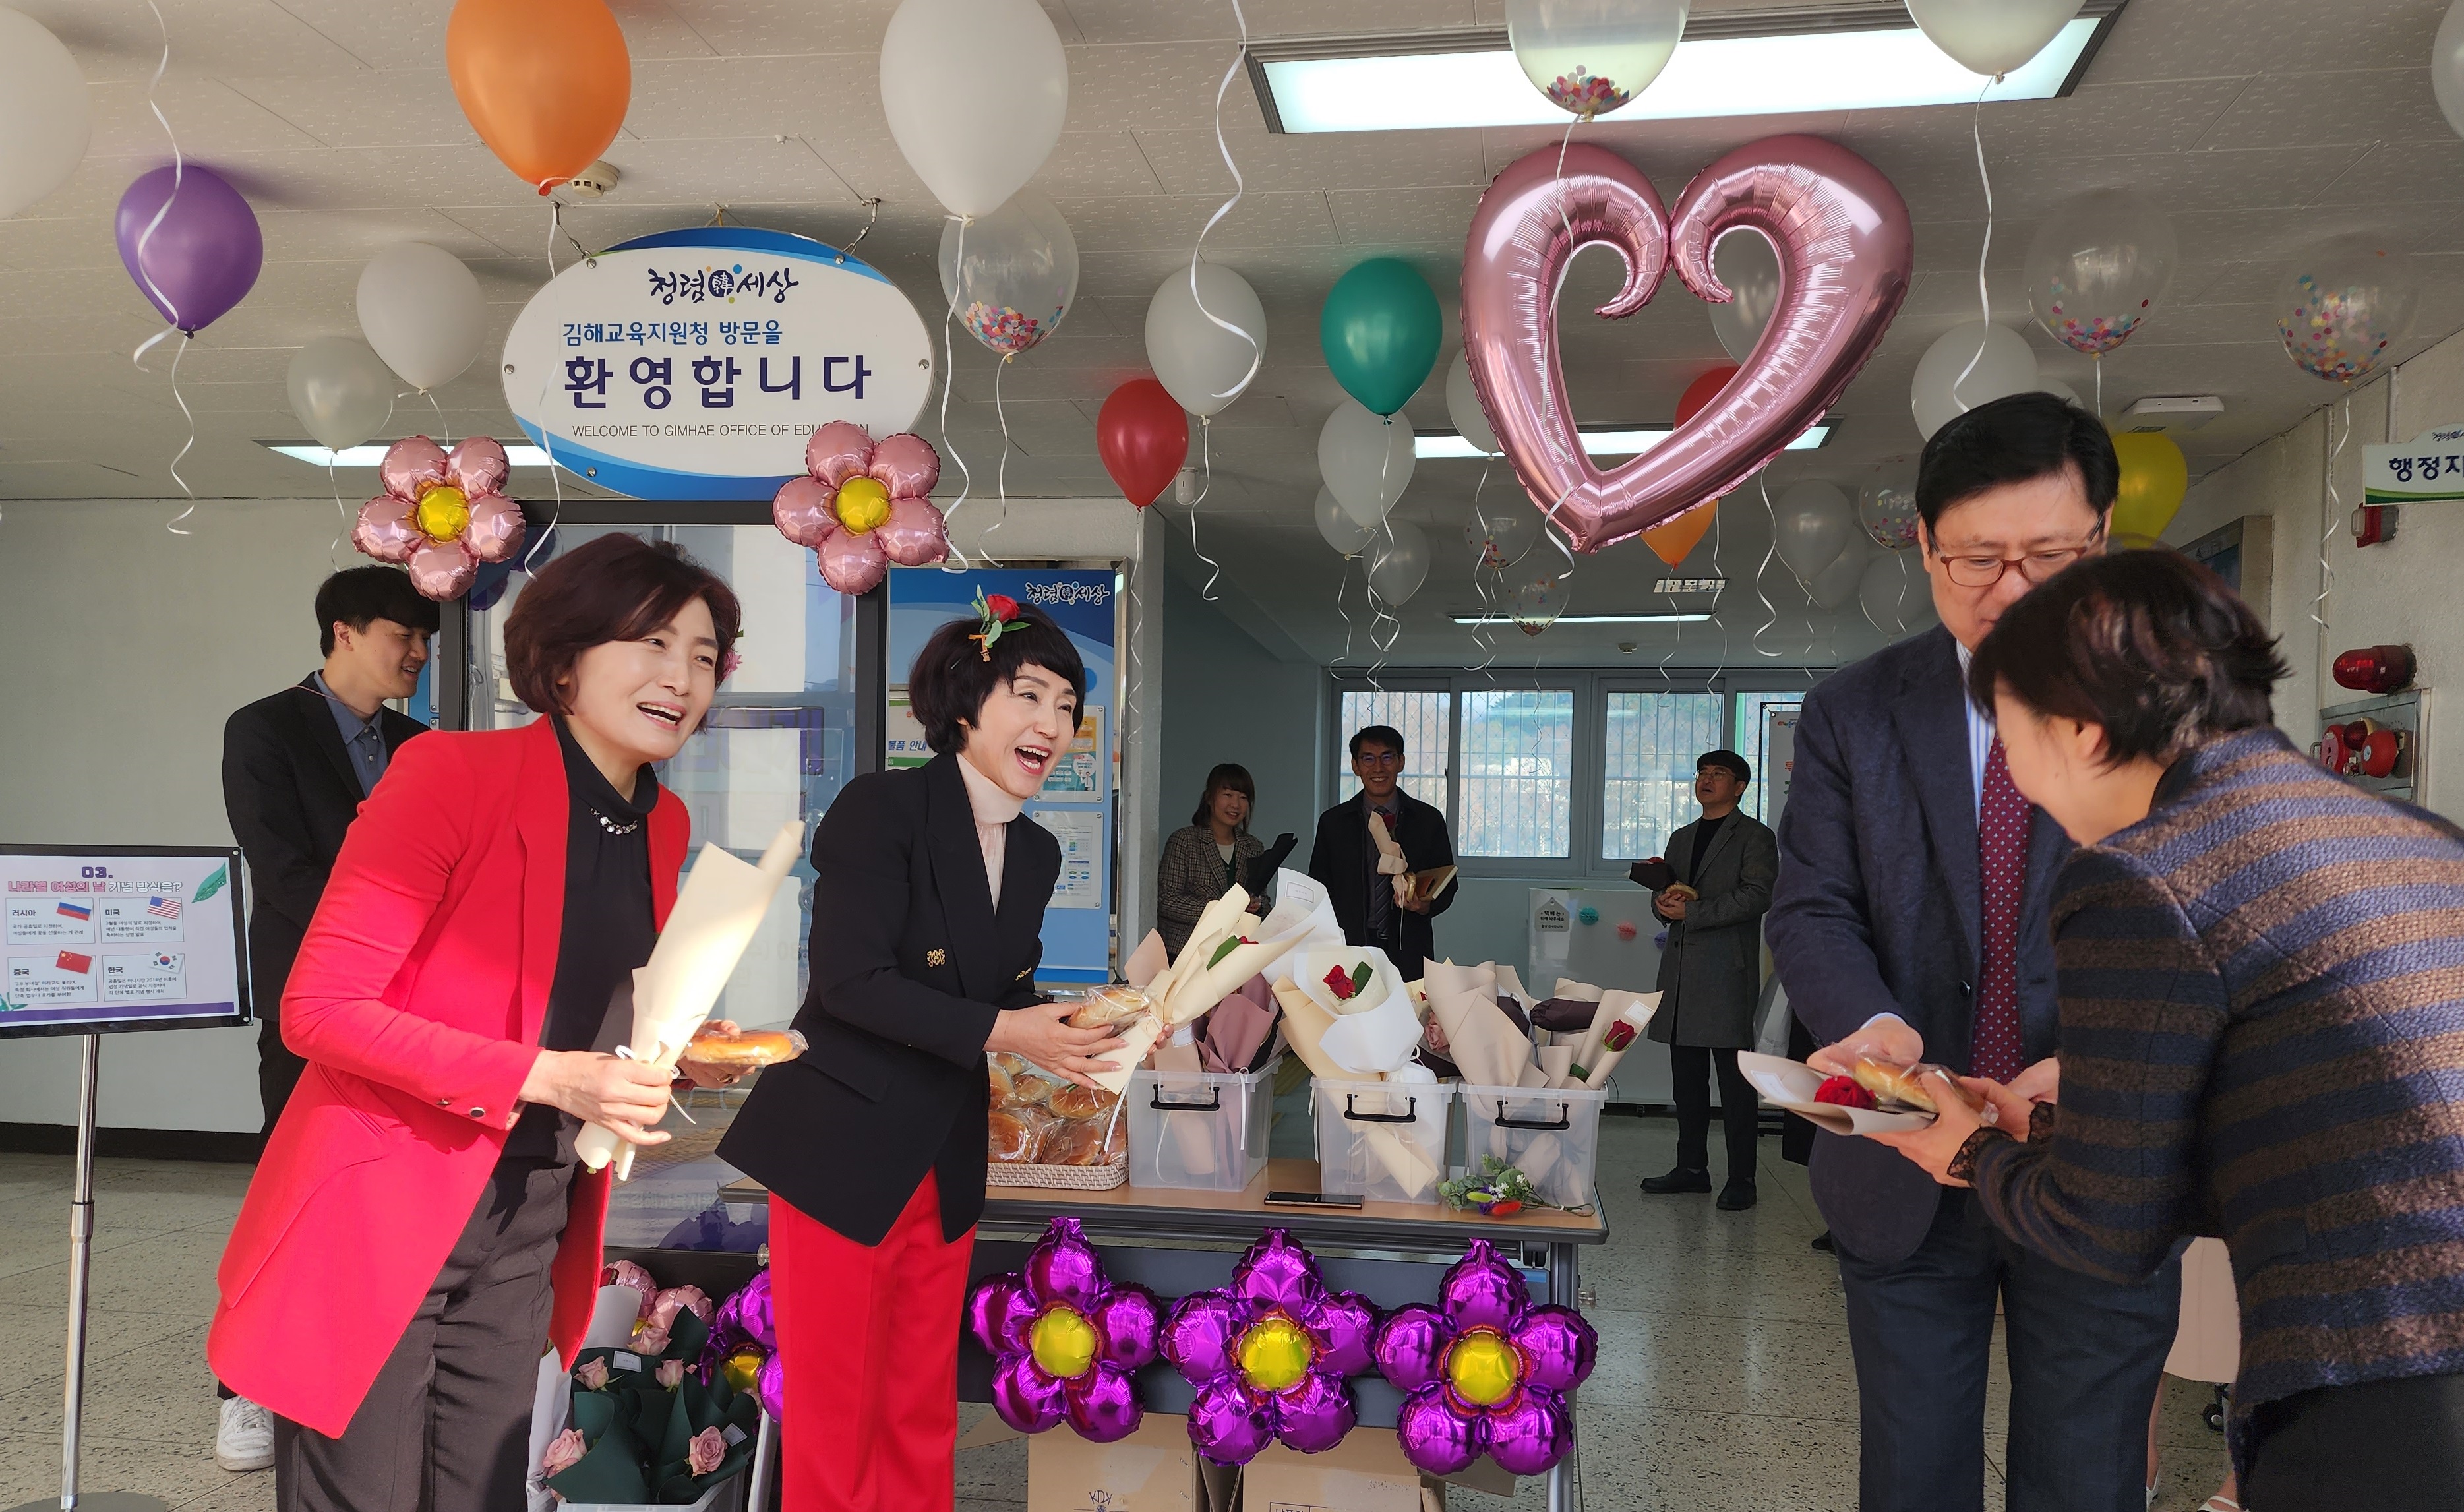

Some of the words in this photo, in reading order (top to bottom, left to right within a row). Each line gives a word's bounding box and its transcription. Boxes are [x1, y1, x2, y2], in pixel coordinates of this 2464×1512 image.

[562, 321, 709, 346] 김해교육지원청
[719, 319, 783, 346] 방문을
[564, 354, 872, 409] 환영합니다
[572, 425, 638, 437] WELCOME
[643, 425, 659, 437] TO
[664, 425, 715, 437] GIMHAE
[719, 425, 766, 437] OFFICE
[771, 424, 789, 436] OF
[888, 740, 905, 751] 물품
[81, 866, 113, 878] 03.
[8, 881, 47, 892] 나라별
[51, 881, 90, 892] 여성의
[92, 881, 106, 892] 날
[108, 881, 133, 892] 기념
[136, 881, 183, 893] 방식은?
